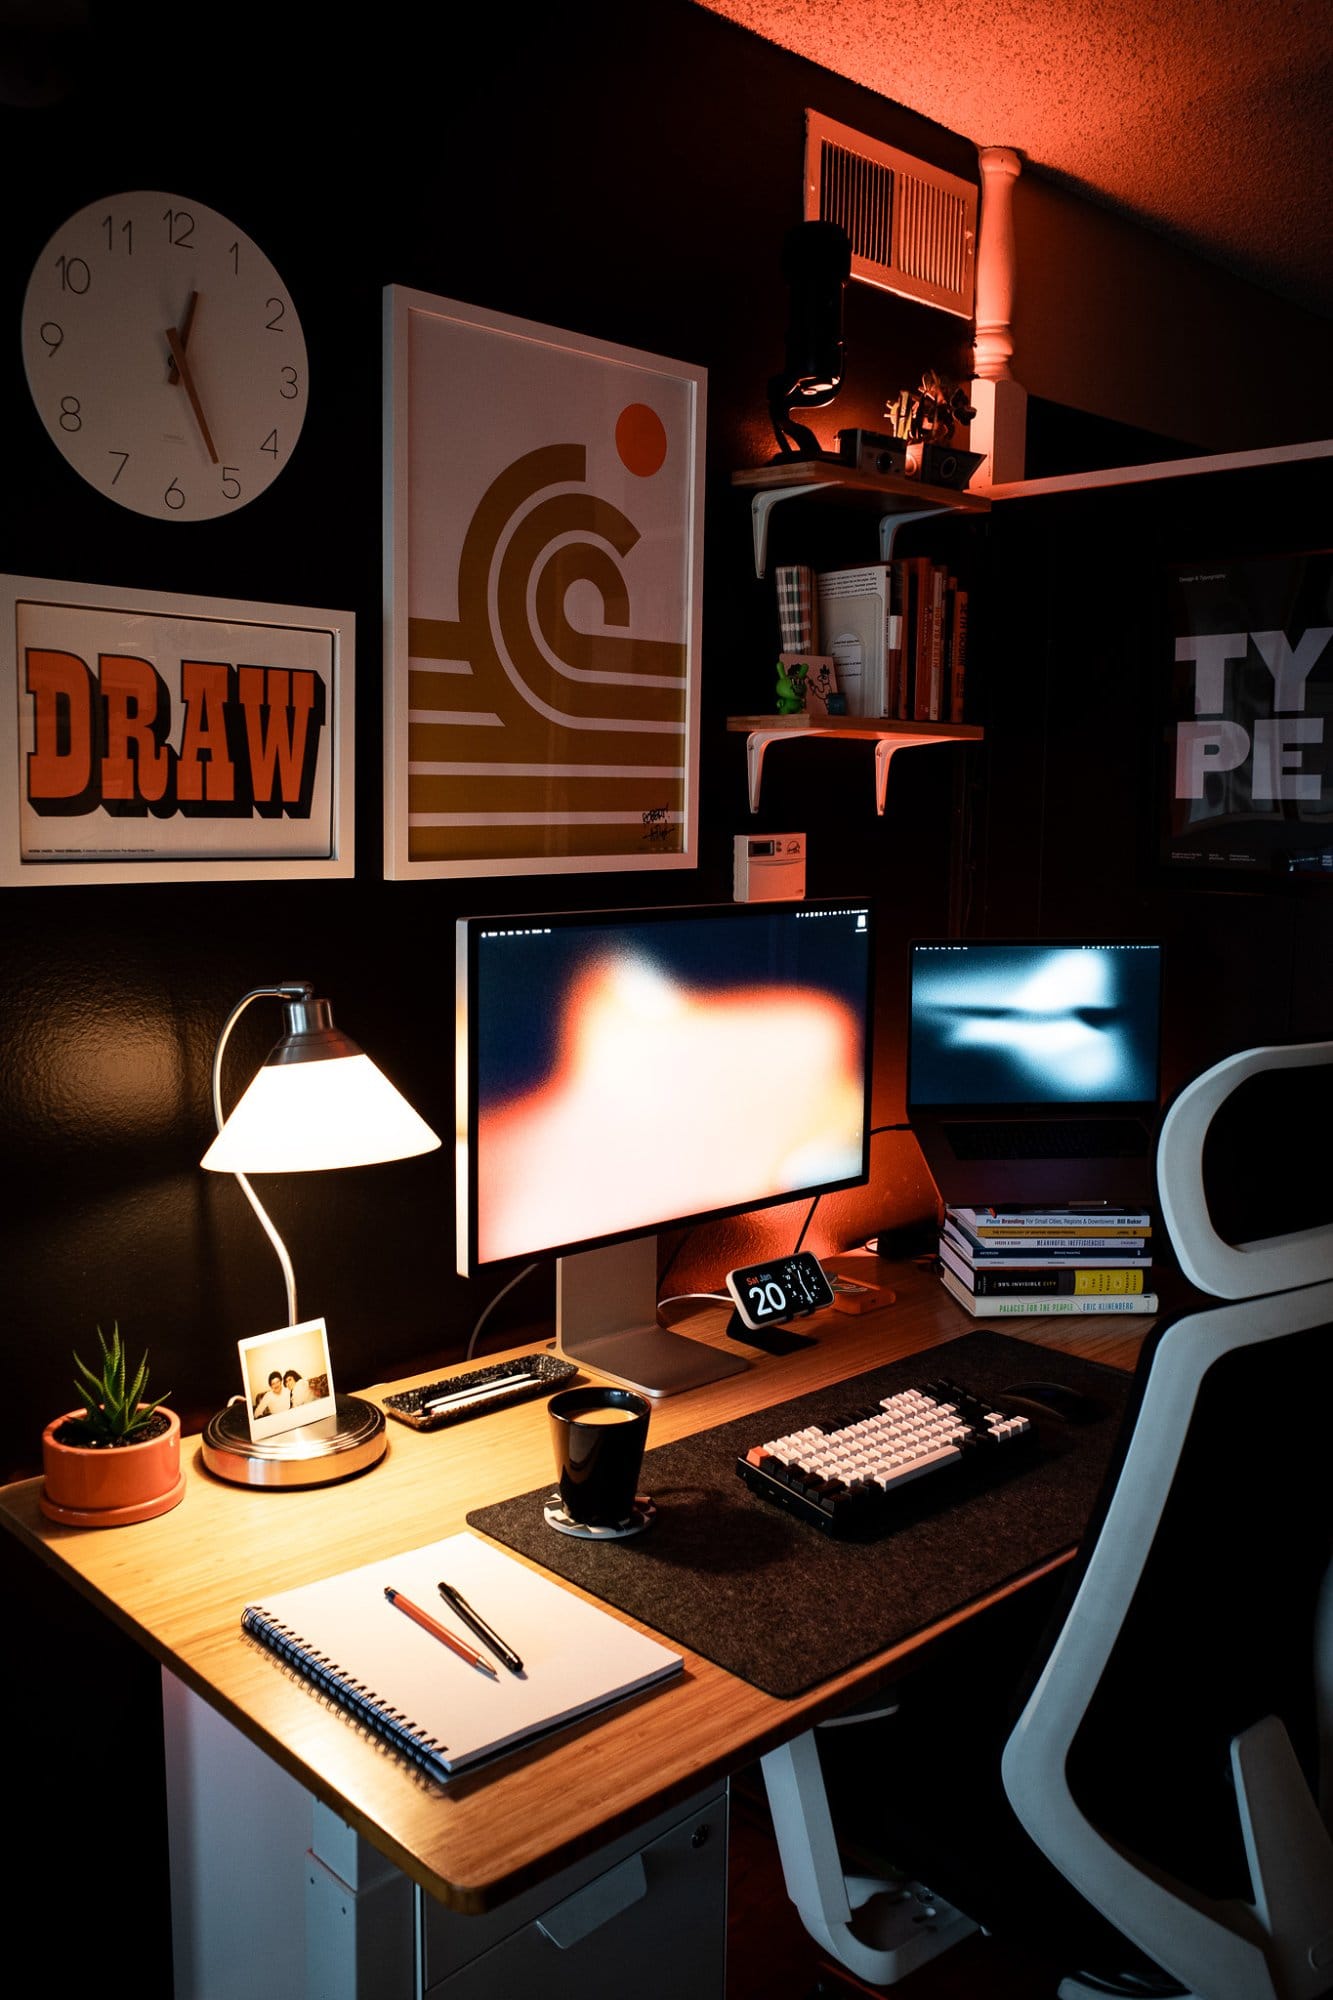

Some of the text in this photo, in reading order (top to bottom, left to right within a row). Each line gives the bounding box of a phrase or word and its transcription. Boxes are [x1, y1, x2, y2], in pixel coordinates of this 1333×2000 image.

[102, 215, 132, 255] 11
[163, 209, 195, 249] 12
[55, 255, 91, 295] 10
[229, 242, 239, 276] 1
[265, 298, 285, 332] 2
[40, 322, 64, 358] 9
[279, 366, 298, 400] 3
[59, 395, 82, 432] 8
[260, 429, 278, 460] 4
[108, 451, 129, 485] 7
[221, 467, 241, 500] 5
[164, 477, 186, 510] 6
[1175, 627, 1333, 714] TY
[25, 648, 326, 819] DRAW
[1175, 718, 1324, 800] PE
[1064, 1218, 1082, 1226] Regions
[749, 1283, 786, 1316] 20
[999, 1302, 1133, 1313] PALACES FOR THE PEOPLE ERIC KLINENBERG
